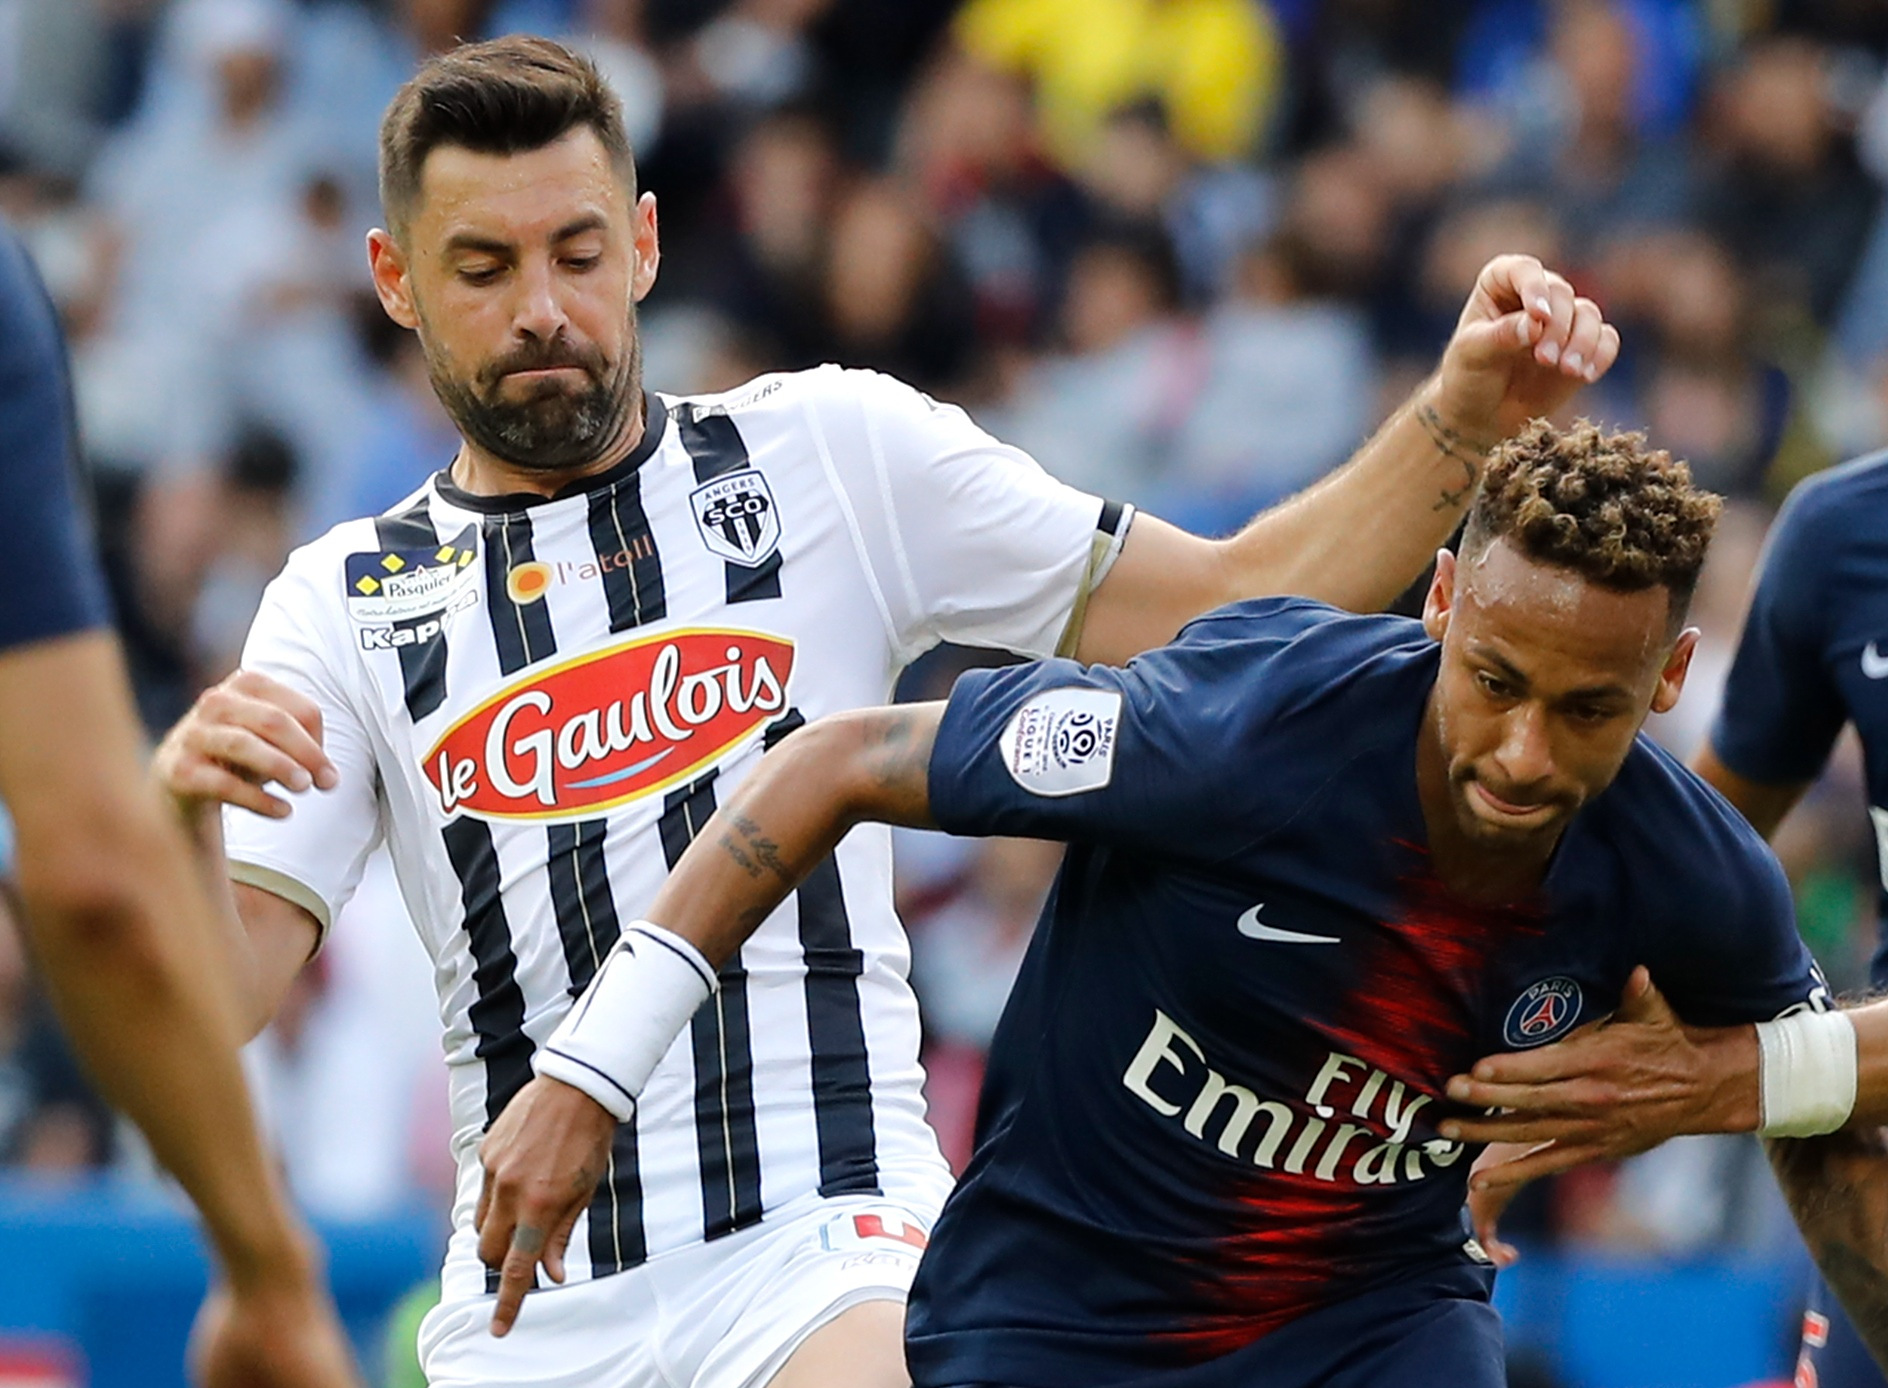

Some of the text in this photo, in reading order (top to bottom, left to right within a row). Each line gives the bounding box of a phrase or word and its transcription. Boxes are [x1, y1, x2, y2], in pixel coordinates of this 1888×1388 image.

[704, 478, 756, 501] ANGERS
[708, 498, 762, 525] SCO
[557, 534, 653, 585] l'atoll
[388, 573, 451, 599] Pasquier
[440, 644, 789, 810] le Gaulois
[1023, 708, 1040, 760] LIGUE
[1098, 718, 1114, 758] PARIS
[1527, 980, 1575, 1000] PARIS
[1304, 1052, 1433, 1145] Fly
